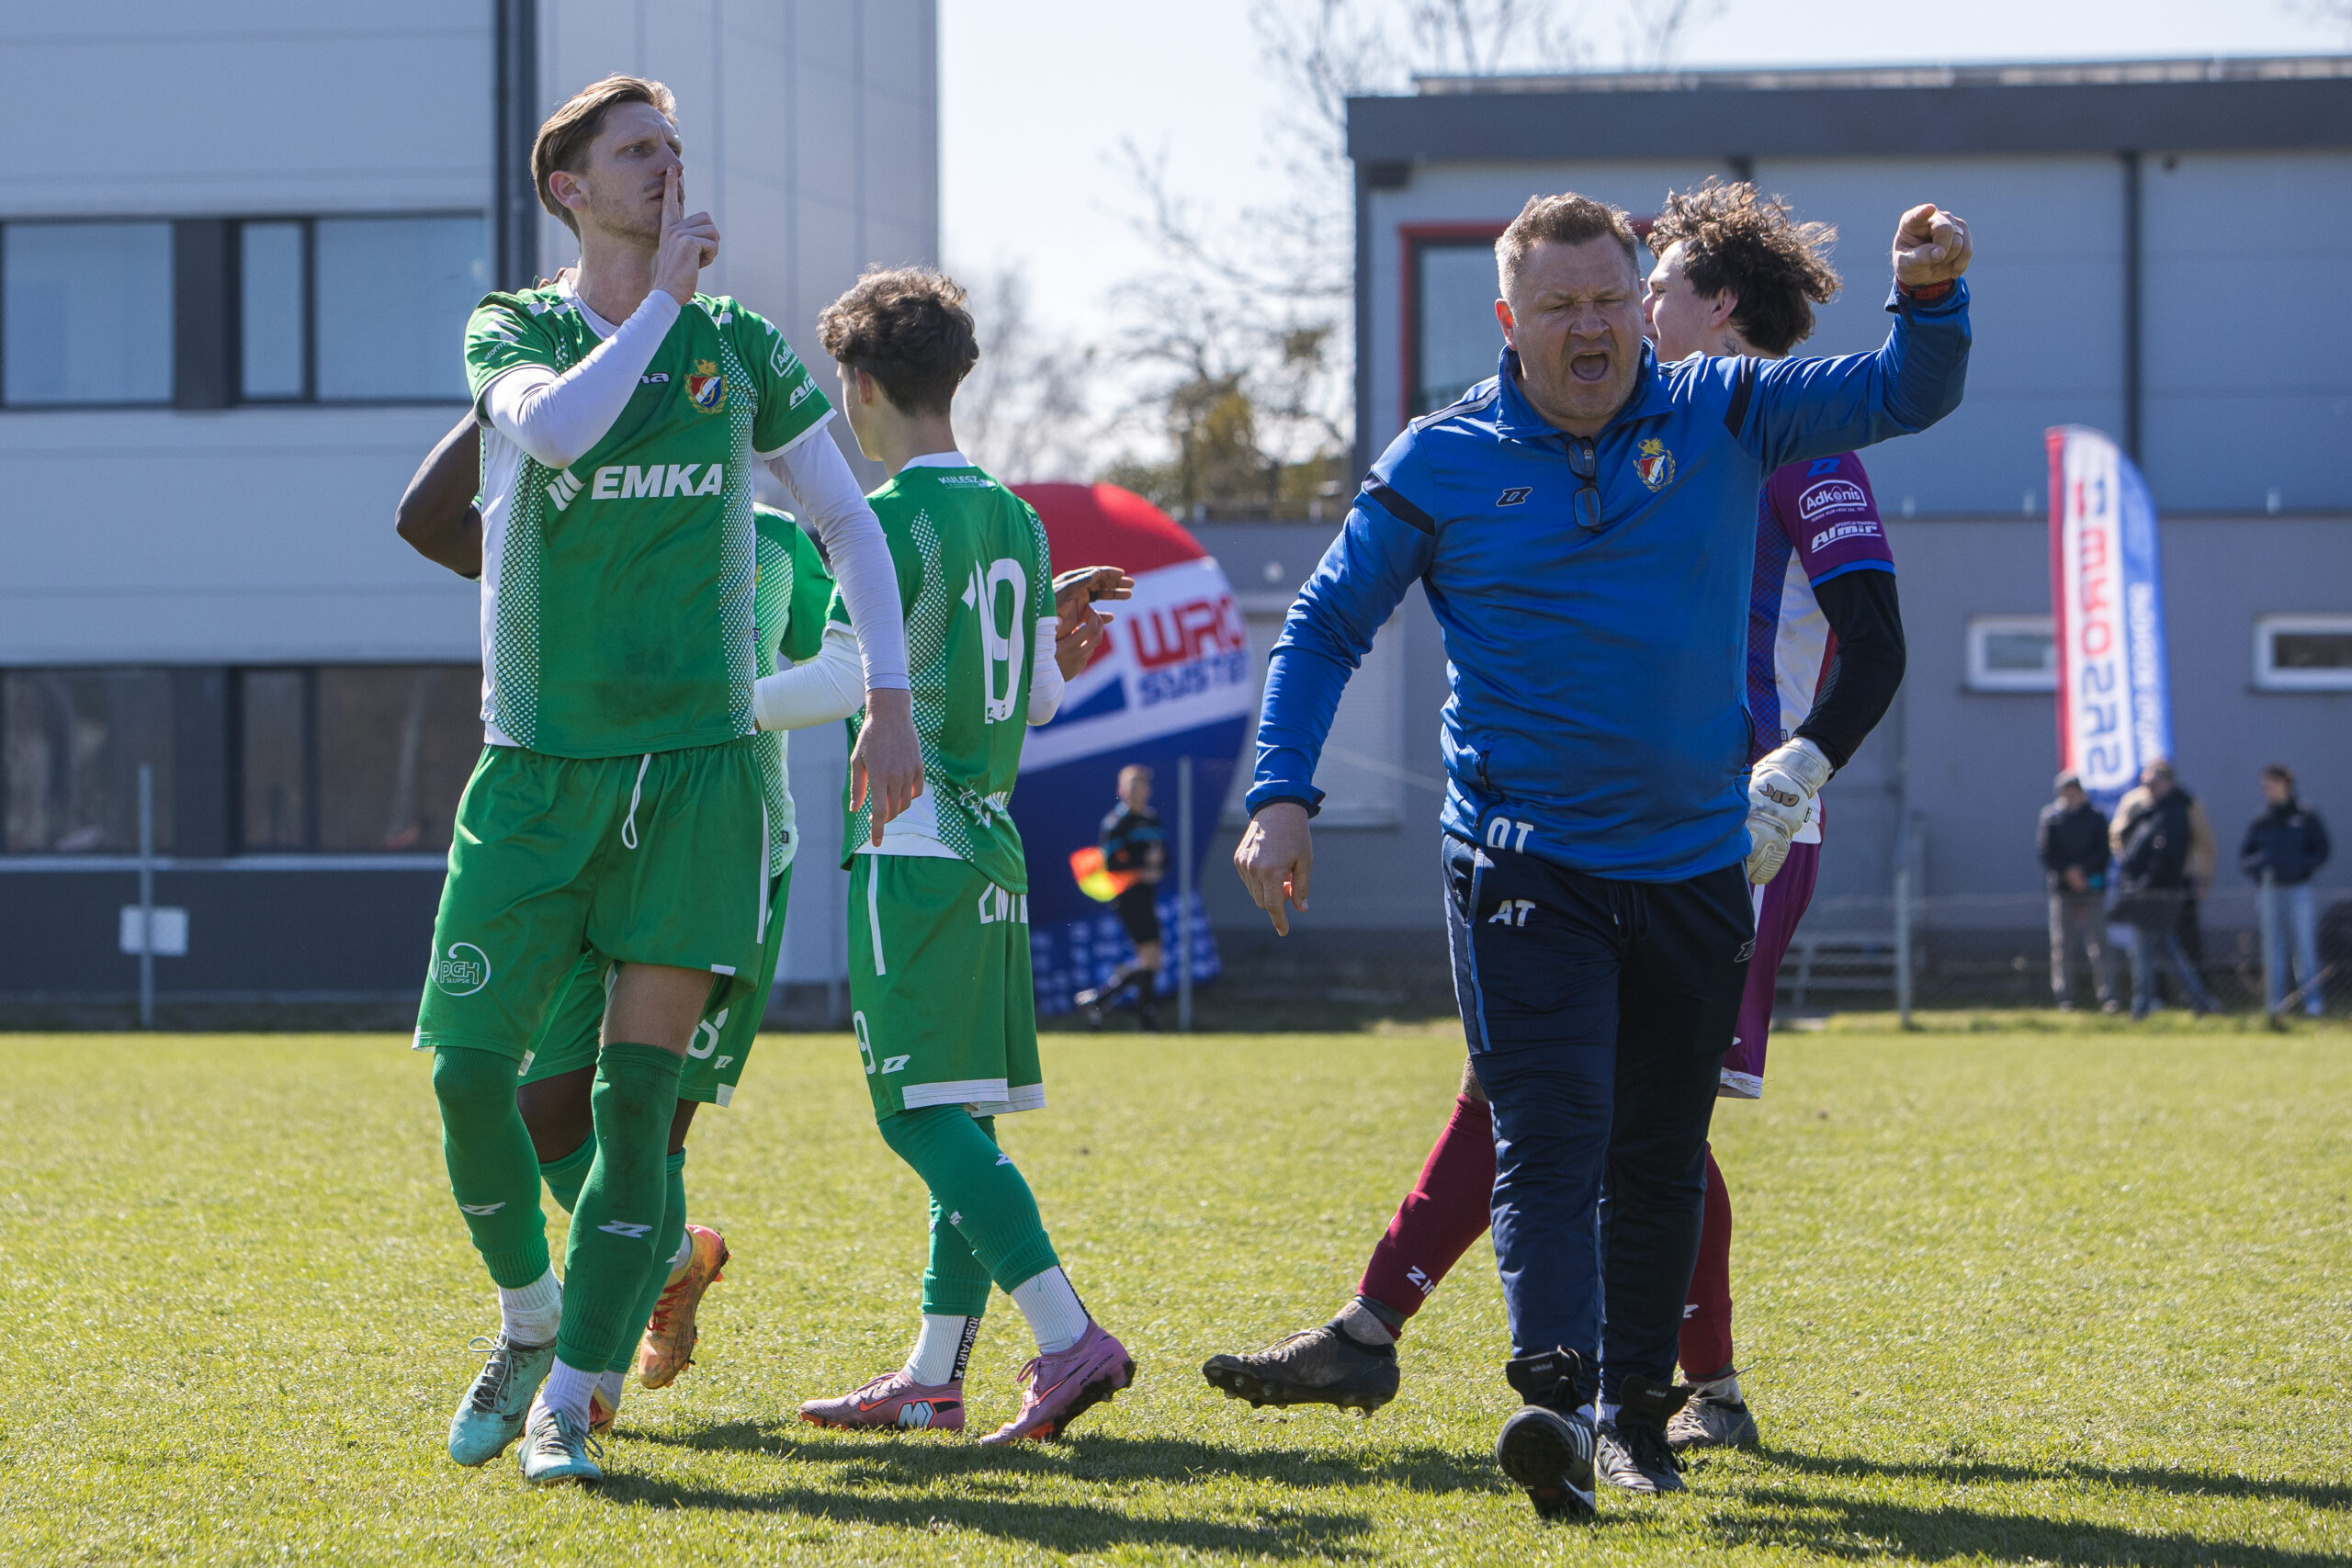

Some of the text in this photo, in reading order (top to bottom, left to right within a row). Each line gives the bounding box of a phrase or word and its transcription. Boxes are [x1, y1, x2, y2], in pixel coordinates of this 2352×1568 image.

[591, 463, 723, 501] EMKA
[1806, 487, 1861, 511] Adkonis
[1812, 525, 1878, 550] Almir
[960, 558, 1027, 725] 19
[1487, 898, 1537, 928] AT
